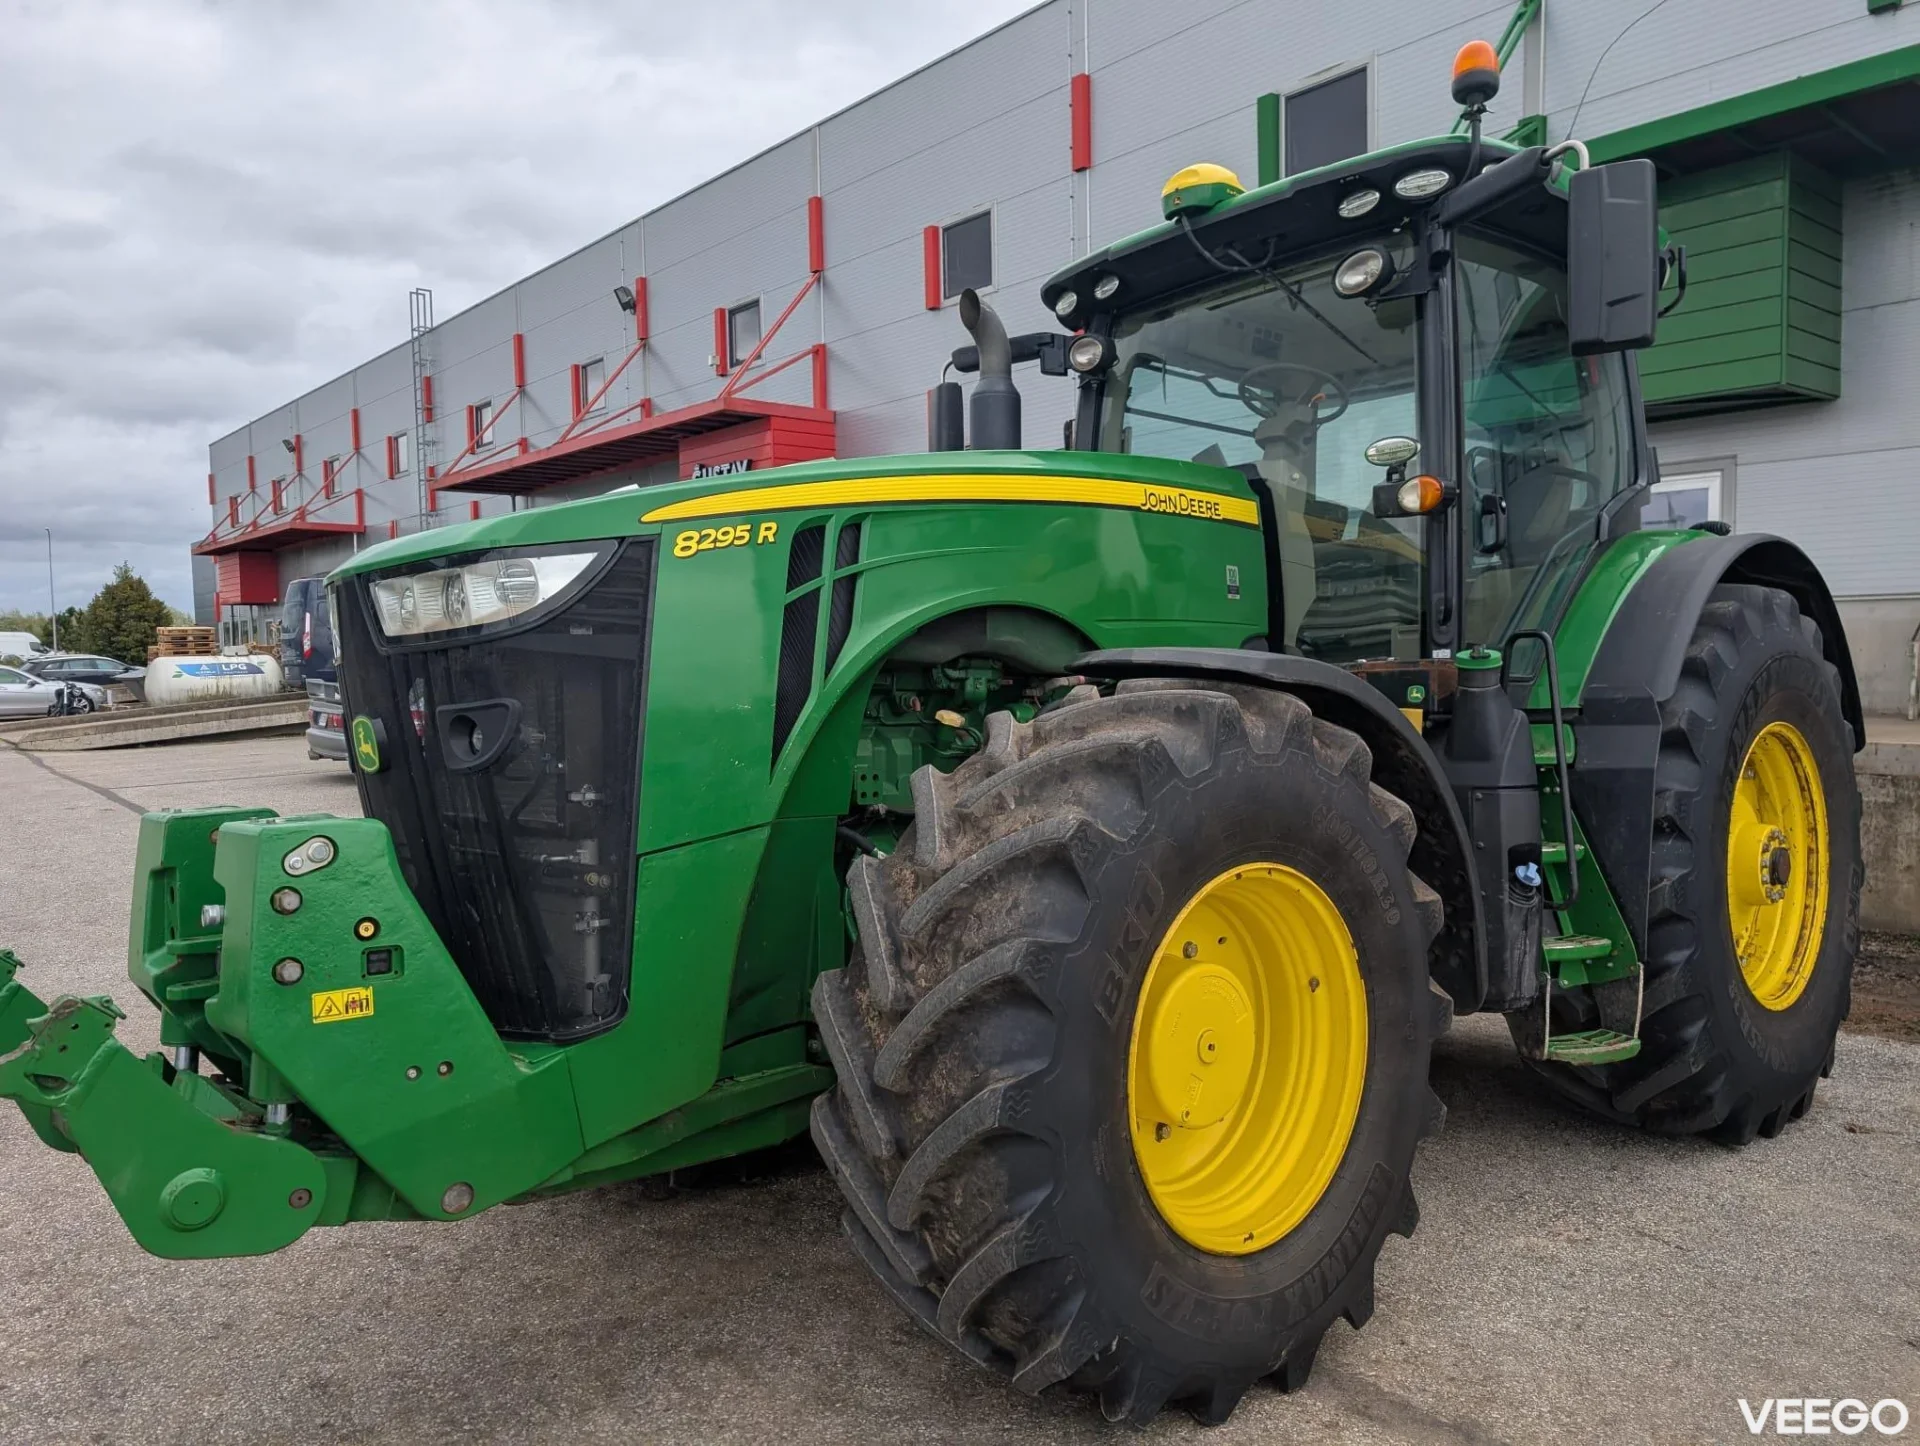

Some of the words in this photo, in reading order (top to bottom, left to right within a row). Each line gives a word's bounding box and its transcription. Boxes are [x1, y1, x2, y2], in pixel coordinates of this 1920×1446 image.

[673, 524, 753, 558] 8295
[756, 521, 778, 545] R
[222, 663, 247, 671] LPG
[1100, 869, 1162, 1019] BKT
